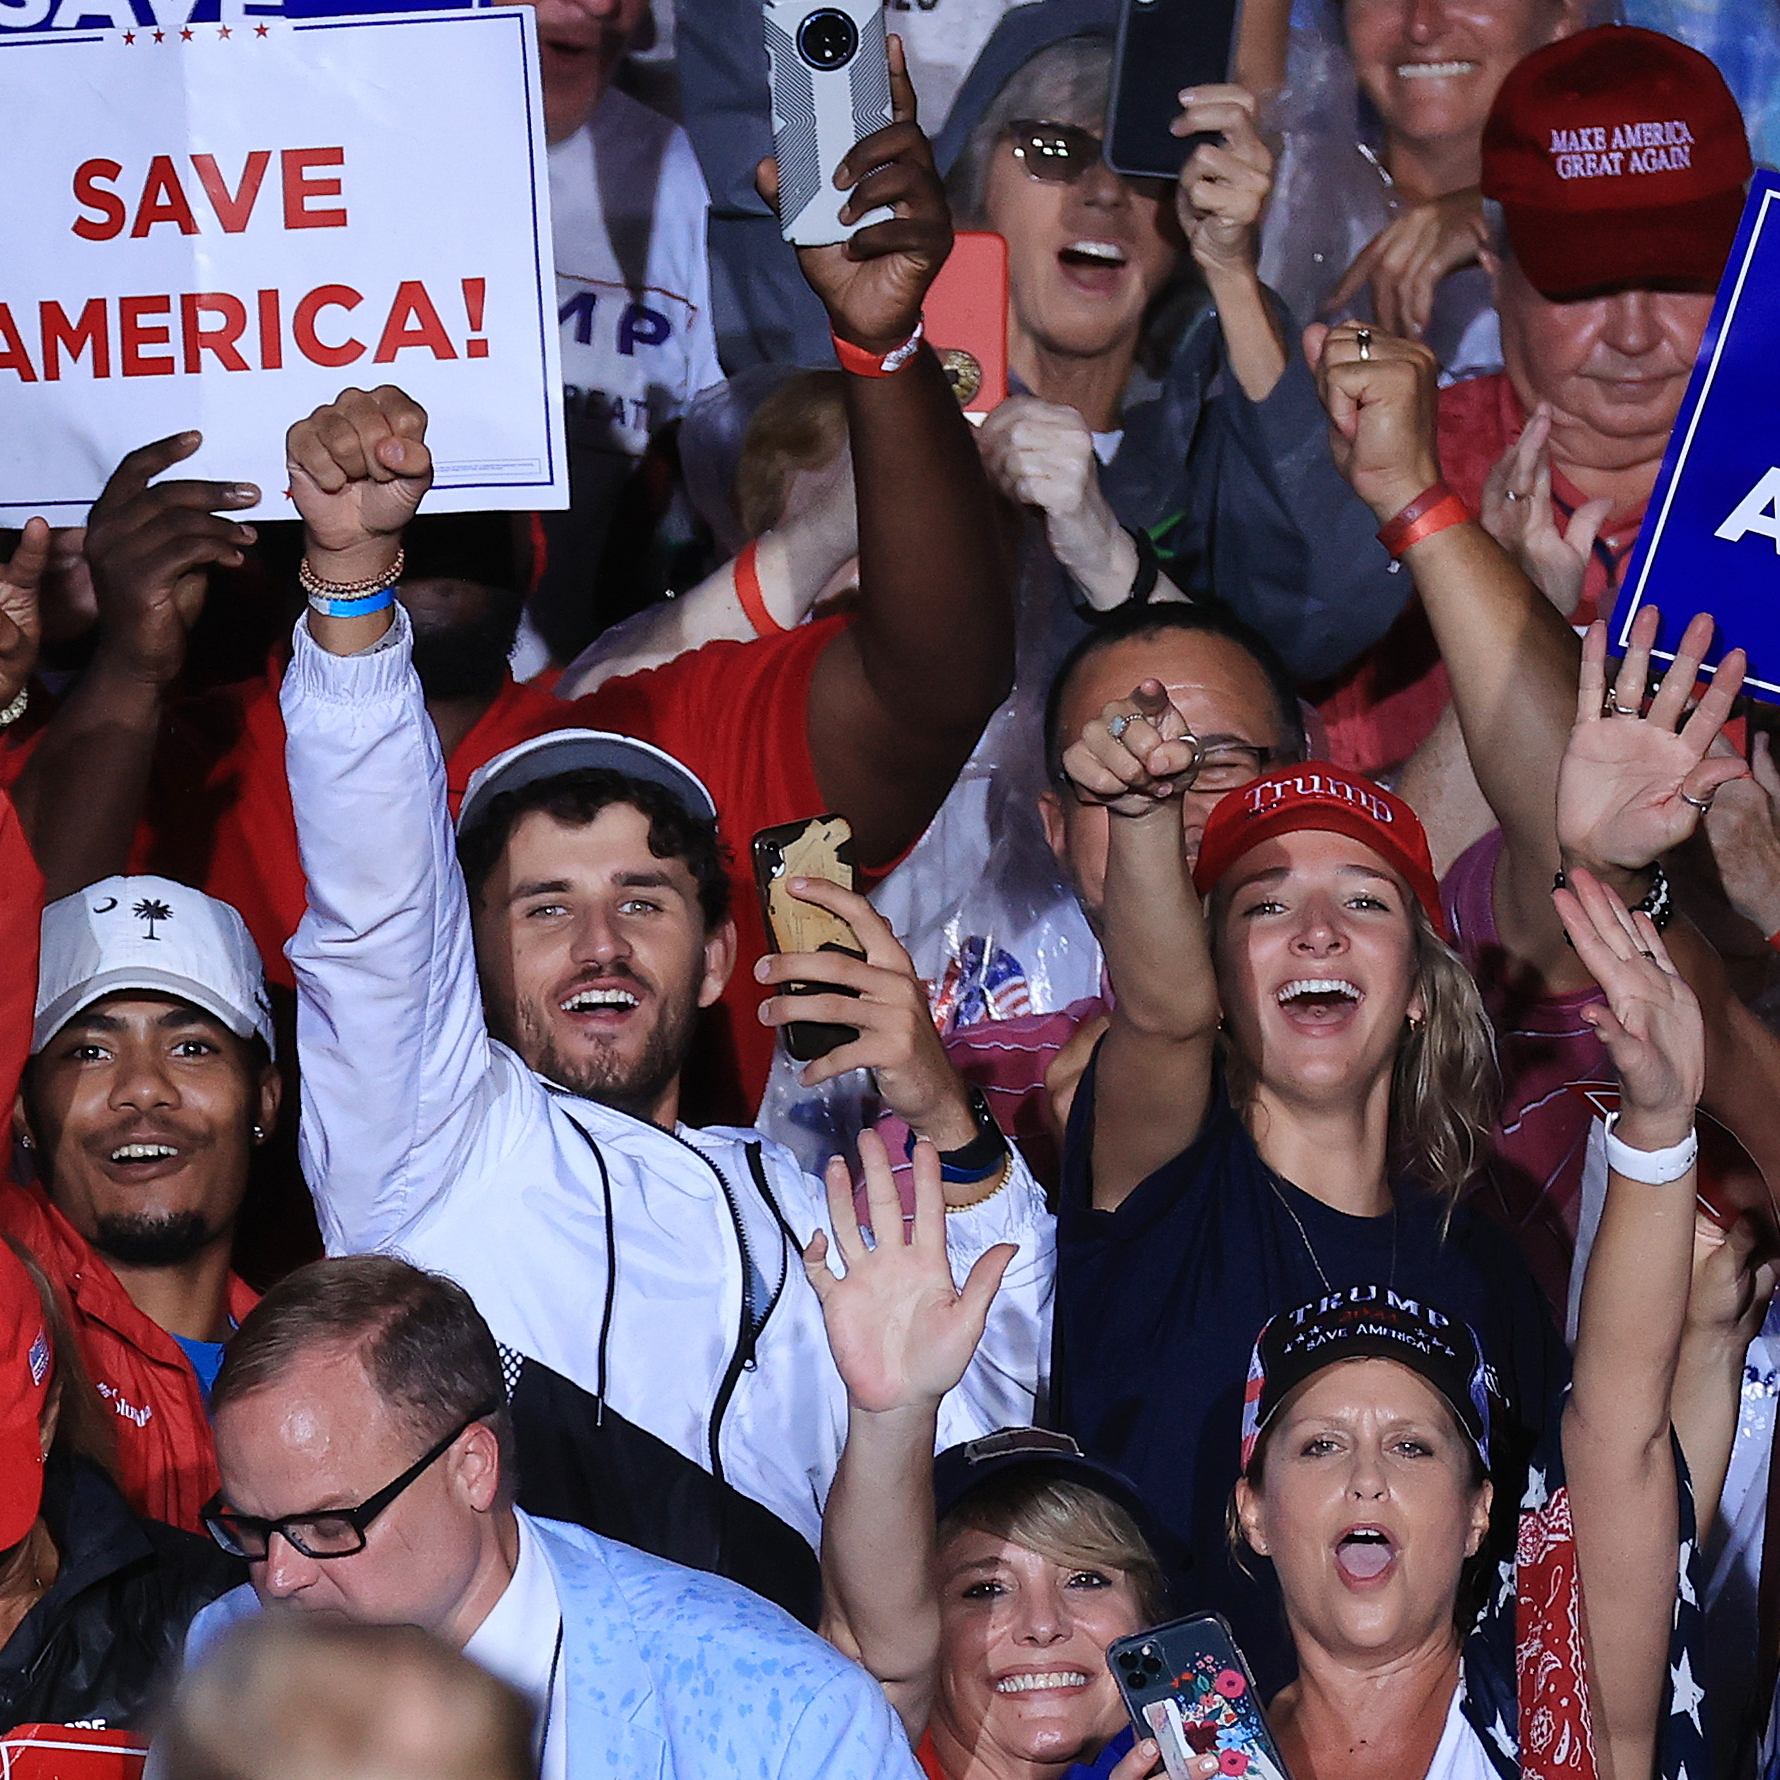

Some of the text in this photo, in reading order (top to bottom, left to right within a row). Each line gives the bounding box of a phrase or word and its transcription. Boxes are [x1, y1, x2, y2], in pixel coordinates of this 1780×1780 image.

[1550, 120, 1694, 155] MAKE AMERICA
[1556, 144, 1692, 179] GREAT AGAIN
[71, 146, 349, 241] SAVE
[1245, 766, 1394, 826] Trump
[1288, 1285, 1450, 1329] TRUMP
[1306, 1327, 1349, 1352] SAVE
